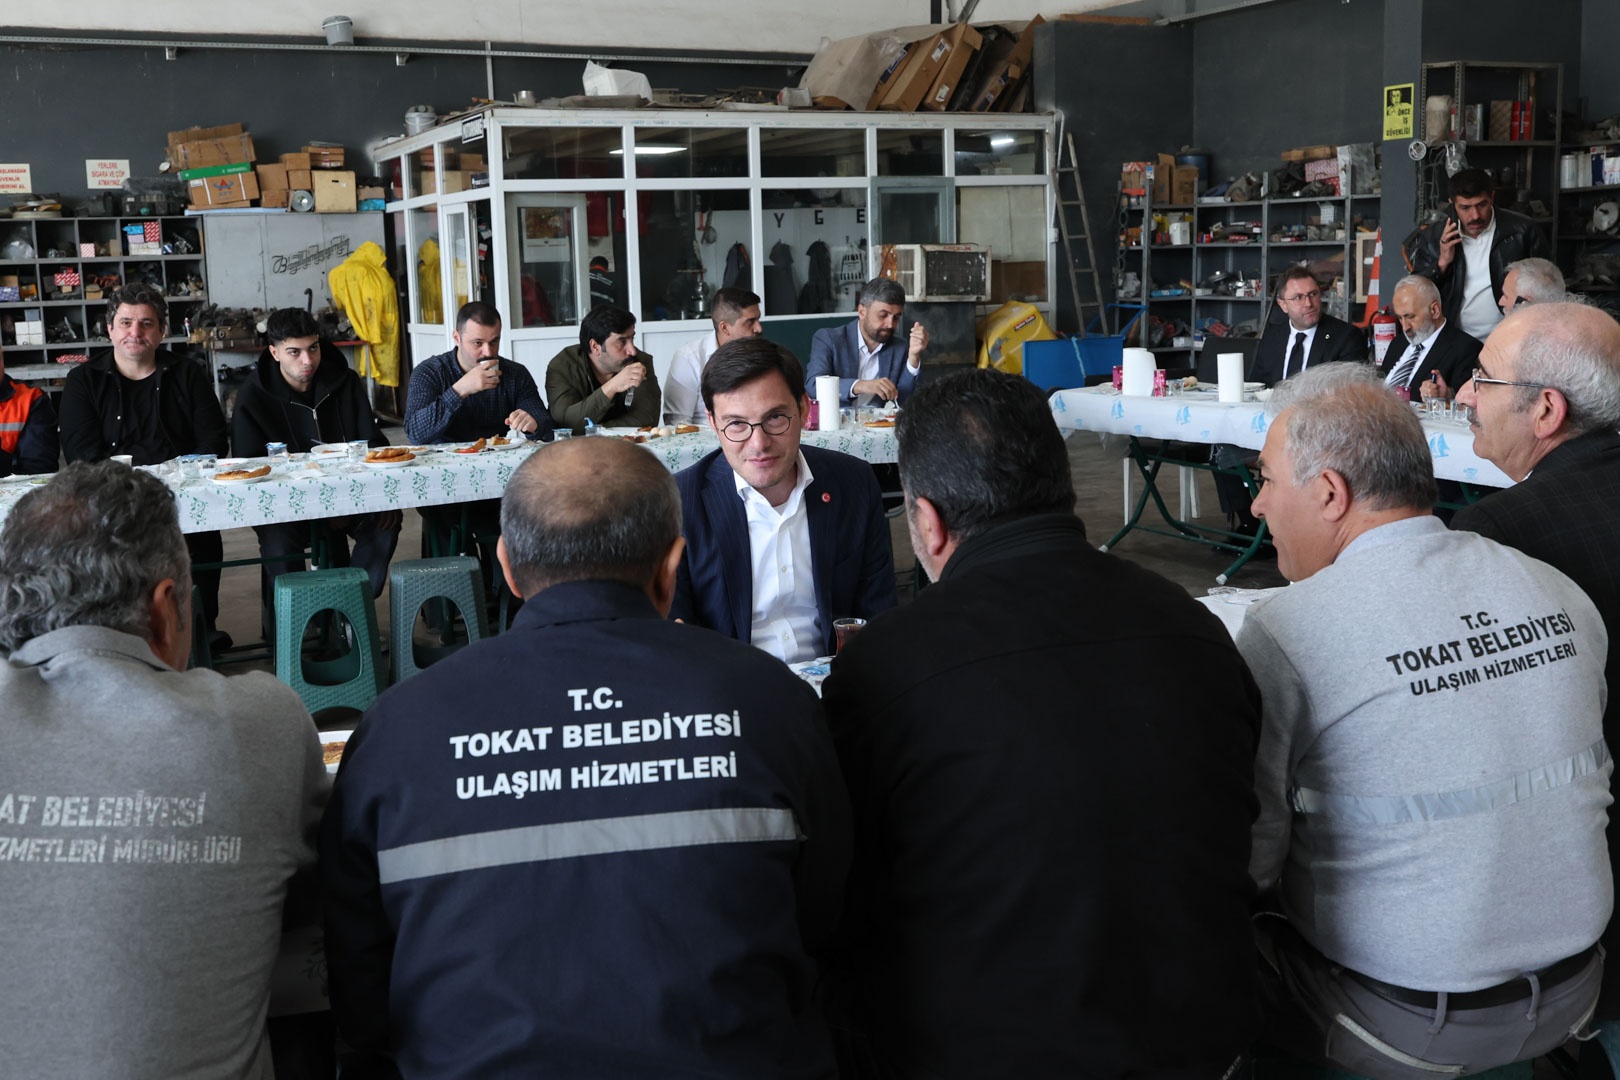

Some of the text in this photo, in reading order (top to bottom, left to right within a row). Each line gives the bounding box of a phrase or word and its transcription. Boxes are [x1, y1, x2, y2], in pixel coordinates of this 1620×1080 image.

[1385, 608, 1576, 676] TOKAT BELEDİYESİ
[1460, 611, 1499, 631] T.C.
[1410, 638, 1577, 696] ULAŞIM HİZMETLERİ
[567, 686, 623, 712] T.C.
[449, 710, 742, 759] TOKAT BELEDİYESİ
[456, 751, 738, 800] ULAŞIM HİZMETLERİ
[41, 789, 206, 827] BELEDİYESİ
